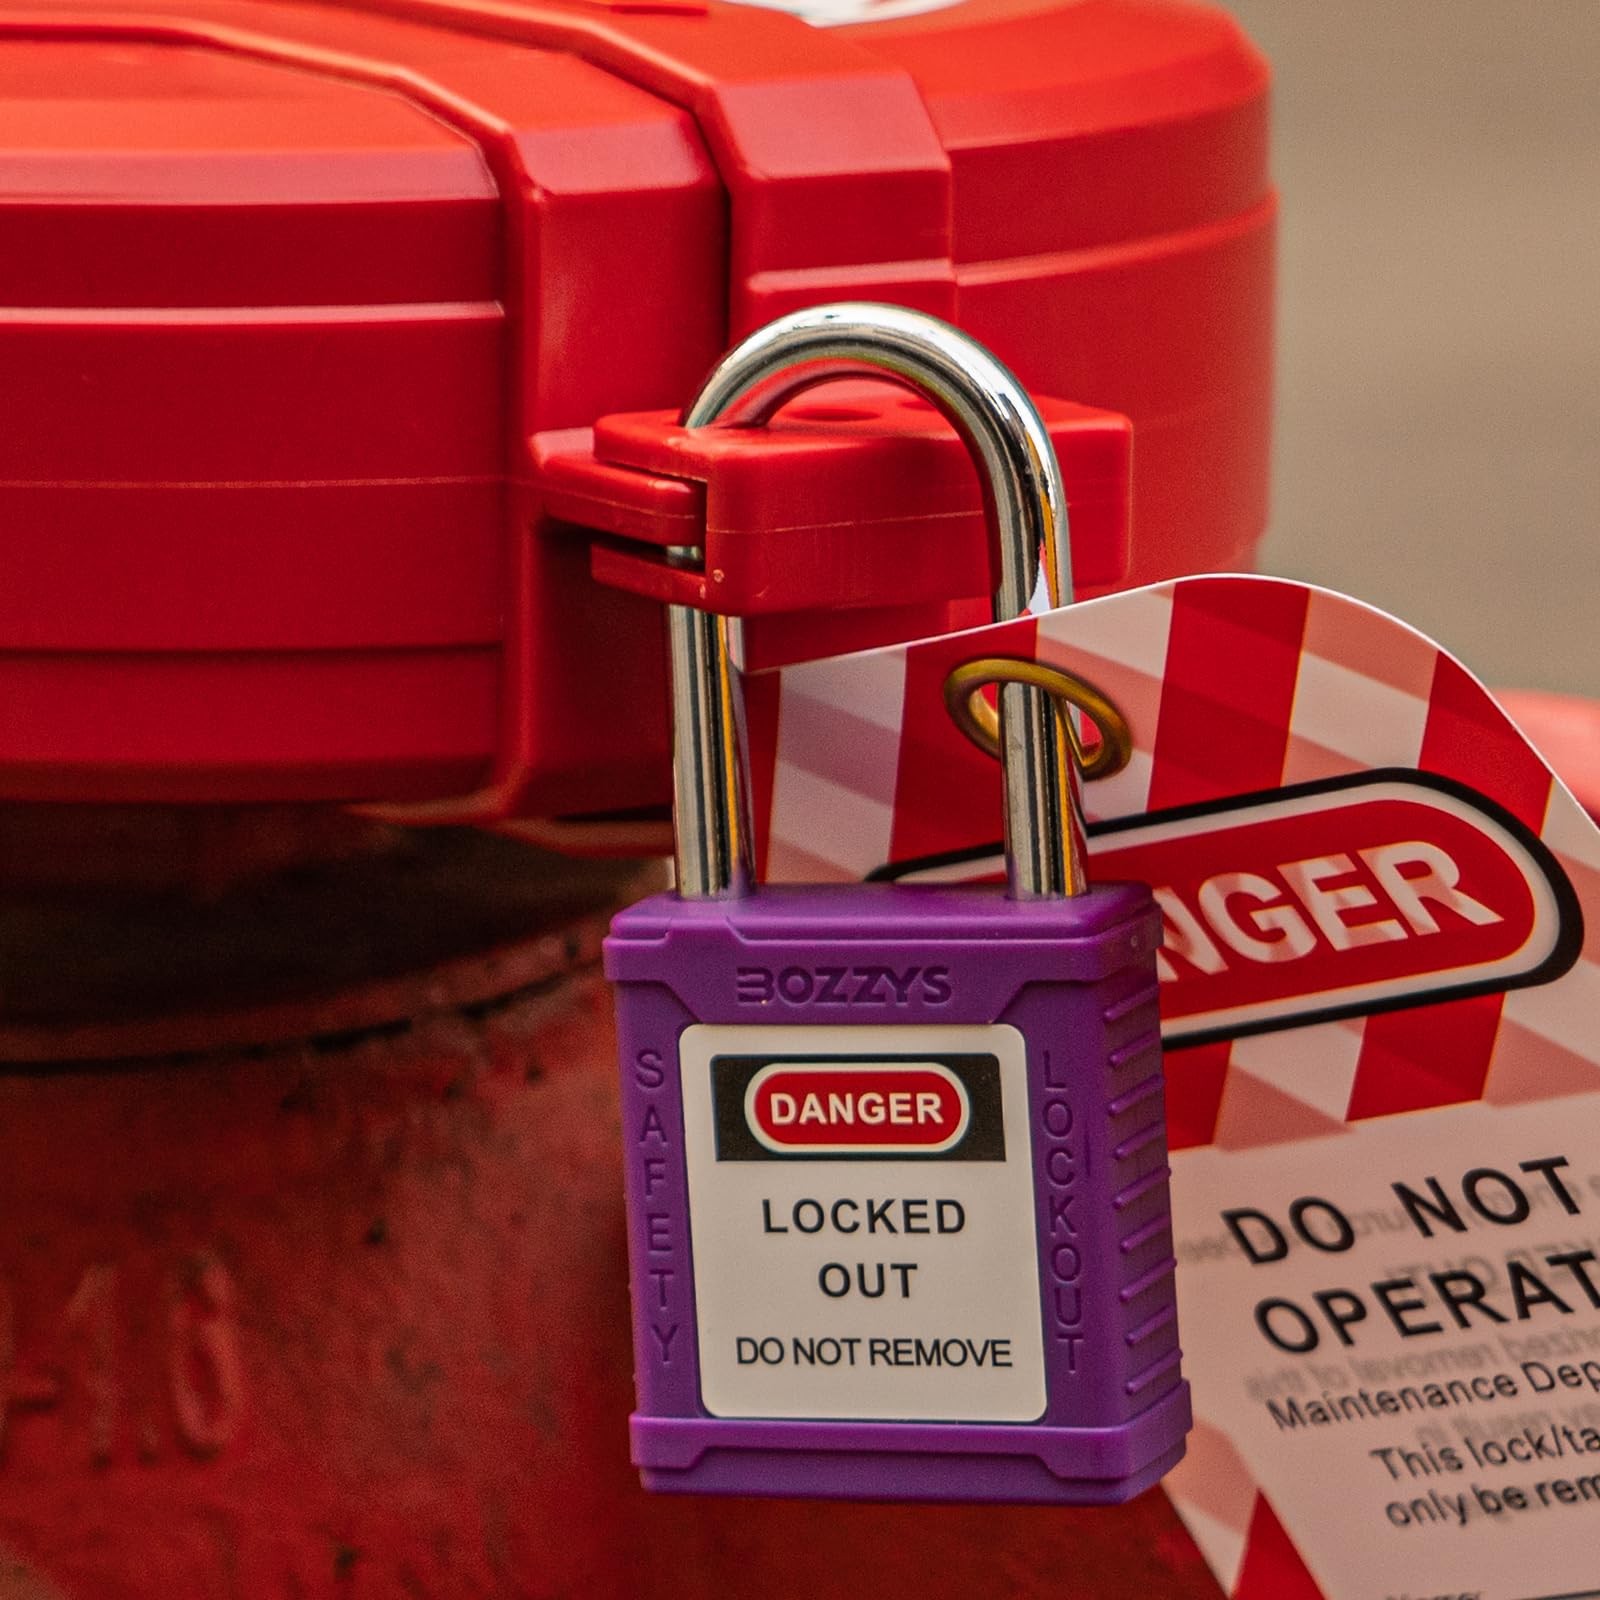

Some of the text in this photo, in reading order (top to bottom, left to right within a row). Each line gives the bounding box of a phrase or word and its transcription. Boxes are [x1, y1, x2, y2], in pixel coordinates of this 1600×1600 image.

[1153, 840, 1505, 982] NGER
[736, 965, 953, 1006] BOZZYS
[769, 1092, 945, 1126] DANGER
[634, 1048, 681, 1365] SAFETY
[761, 1198, 966, 1236] LOCKED
[1041, 1050, 1085, 1375] LOCKOUT
[1220, 1196, 1355, 1265] DO
[1390, 1155, 1581, 1237] NOT
[817, 1262, 918, 1299] OUT
[1253, 1250, 1600, 1354] OPERAT
[736, 1336, 1014, 1369] DO NOT REMOVE
[1265, 1372, 1519, 1430] Maintenance
[1369, 1443, 1463, 1481] This
[1385, 1489, 1468, 1528] only
[1470, 1482, 1528, 1514] be
